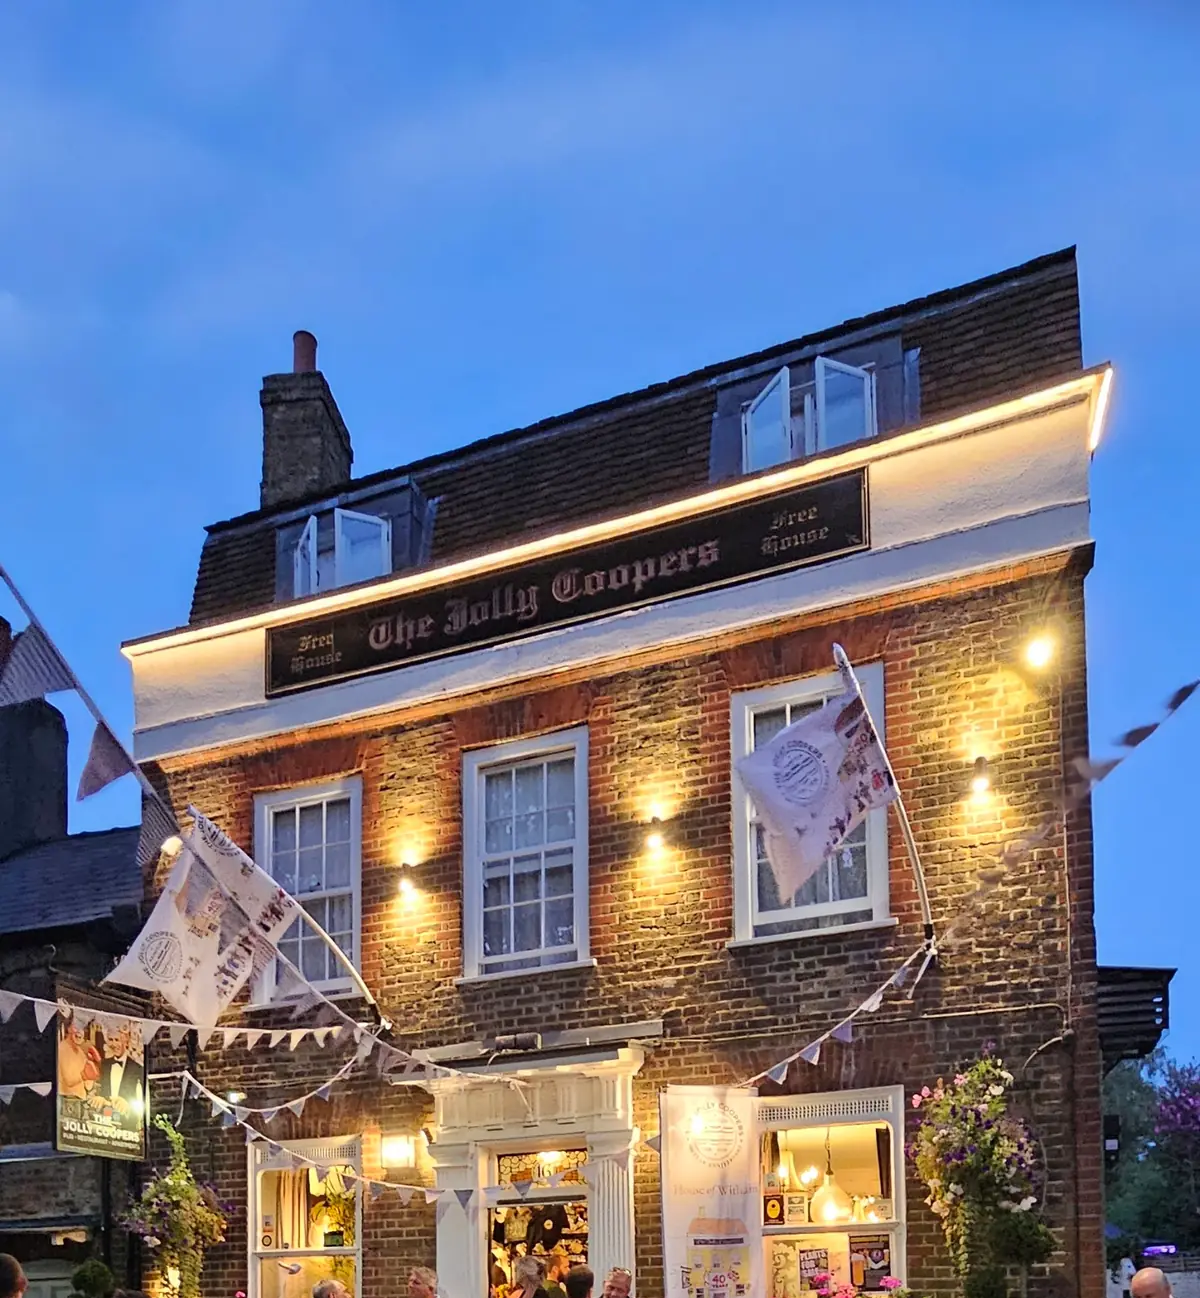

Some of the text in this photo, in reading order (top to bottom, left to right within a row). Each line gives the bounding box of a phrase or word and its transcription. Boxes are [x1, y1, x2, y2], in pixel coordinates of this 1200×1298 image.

[769, 505, 819, 531] Free
[760, 525, 830, 556] House
[368, 536, 722, 650] The Jolly Coopers
[298, 633, 334, 652] Free
[290, 651, 343, 673] House
[93, 1113, 113, 1125] THE
[718, 1102, 745, 1136] COOPERS
[63, 1120, 140, 1143] JOLLY COOPERS
[712, 1275, 726, 1284] 40
